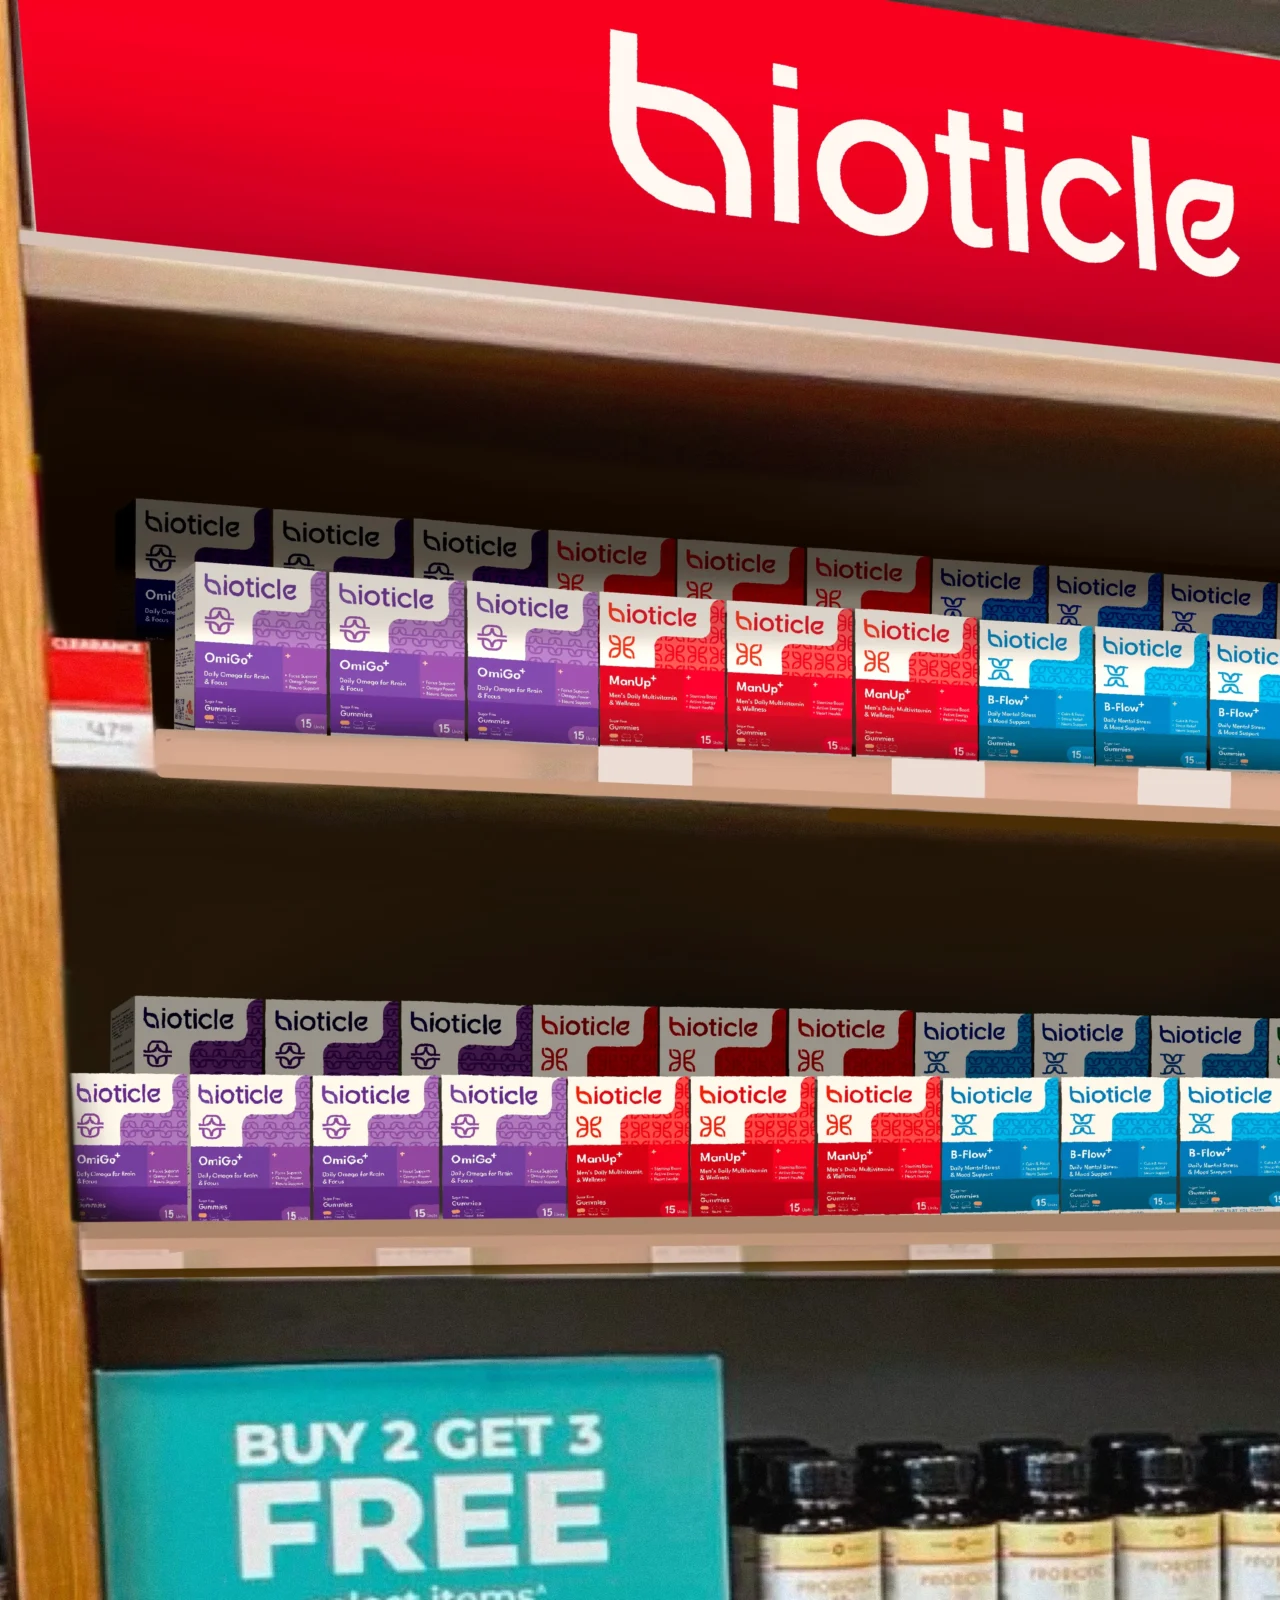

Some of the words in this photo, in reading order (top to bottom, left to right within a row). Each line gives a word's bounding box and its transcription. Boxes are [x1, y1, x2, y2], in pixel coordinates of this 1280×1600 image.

[609, 28, 1240, 278] bioticle
[145, 510, 240, 538] bioticle
[282, 520, 380, 548] bioticle
[423, 529, 517, 558] bioticle
[557, 540, 647, 566] bioticle
[686, 550, 776, 574] bioticle
[815, 557, 902, 582] bioticle
[204, 573, 297, 600] bioticle
[940, 568, 1021, 590] bioticle
[1056, 576, 1136, 597] bioticle
[339, 582, 434, 610] bioticle
[476, 592, 568, 620] bioticle
[1171, 584, 1250, 606] bioticle
[609, 602, 697, 627] bioticle
[736, 610, 824, 635] bioticle
[863, 618, 950, 643] bioticle
[987, 629, 1068, 651] bioticle
[1103, 636, 1182, 658] bioticle
[220, 672, 243, 680] Omega
[204, 704, 237, 713] Gummies
[300, 719, 312, 729] 15
[609, 723, 640, 732] Gummies
[700, 735, 712, 744] 15
[987, 739, 1016, 747] Gummies
[1072, 750, 1081, 759] 15
[143, 1007, 234, 1030] bioticle
[275, 1010, 368, 1032] bioticle
[410, 1012, 501, 1035] bioticle
[541, 1015, 630, 1036] bioticle
[669, 1016, 758, 1038] bioticle
[798, 1018, 885, 1040] bioticle
[924, 1022, 1005, 1042] bioticle
[1042, 1023, 1123, 1042] bioticle
[1160, 1025, 1242, 1044] bioticle
[76, 1082, 160, 1104] bioticle
[198, 1084, 282, 1105] bioticle
[322, 1084, 410, 1105] bioticle
[450, 1084, 538, 1105] bioticle
[576, 1086, 662, 1104] bioticle
[700, 1085, 786, 1104] bioticle
[826, 1084, 912, 1104] bioticle
[951, 1086, 1032, 1104] bioticle
[1070, 1086, 1152, 1104] bioticle
[1188, 1086, 1272, 1104] bioticle
[414, 1208, 426, 1218] 15
[789, 1202, 800, 1212] 15
[1036, 1198, 1046, 1207] 15
[234, 1421, 367, 1466] BUY
[384, 1419, 420, 1462] 2
[436, 1415, 554, 1459] GET
[567, 1414, 604, 1456] 3
[236, 1469, 610, 1580] FREE
